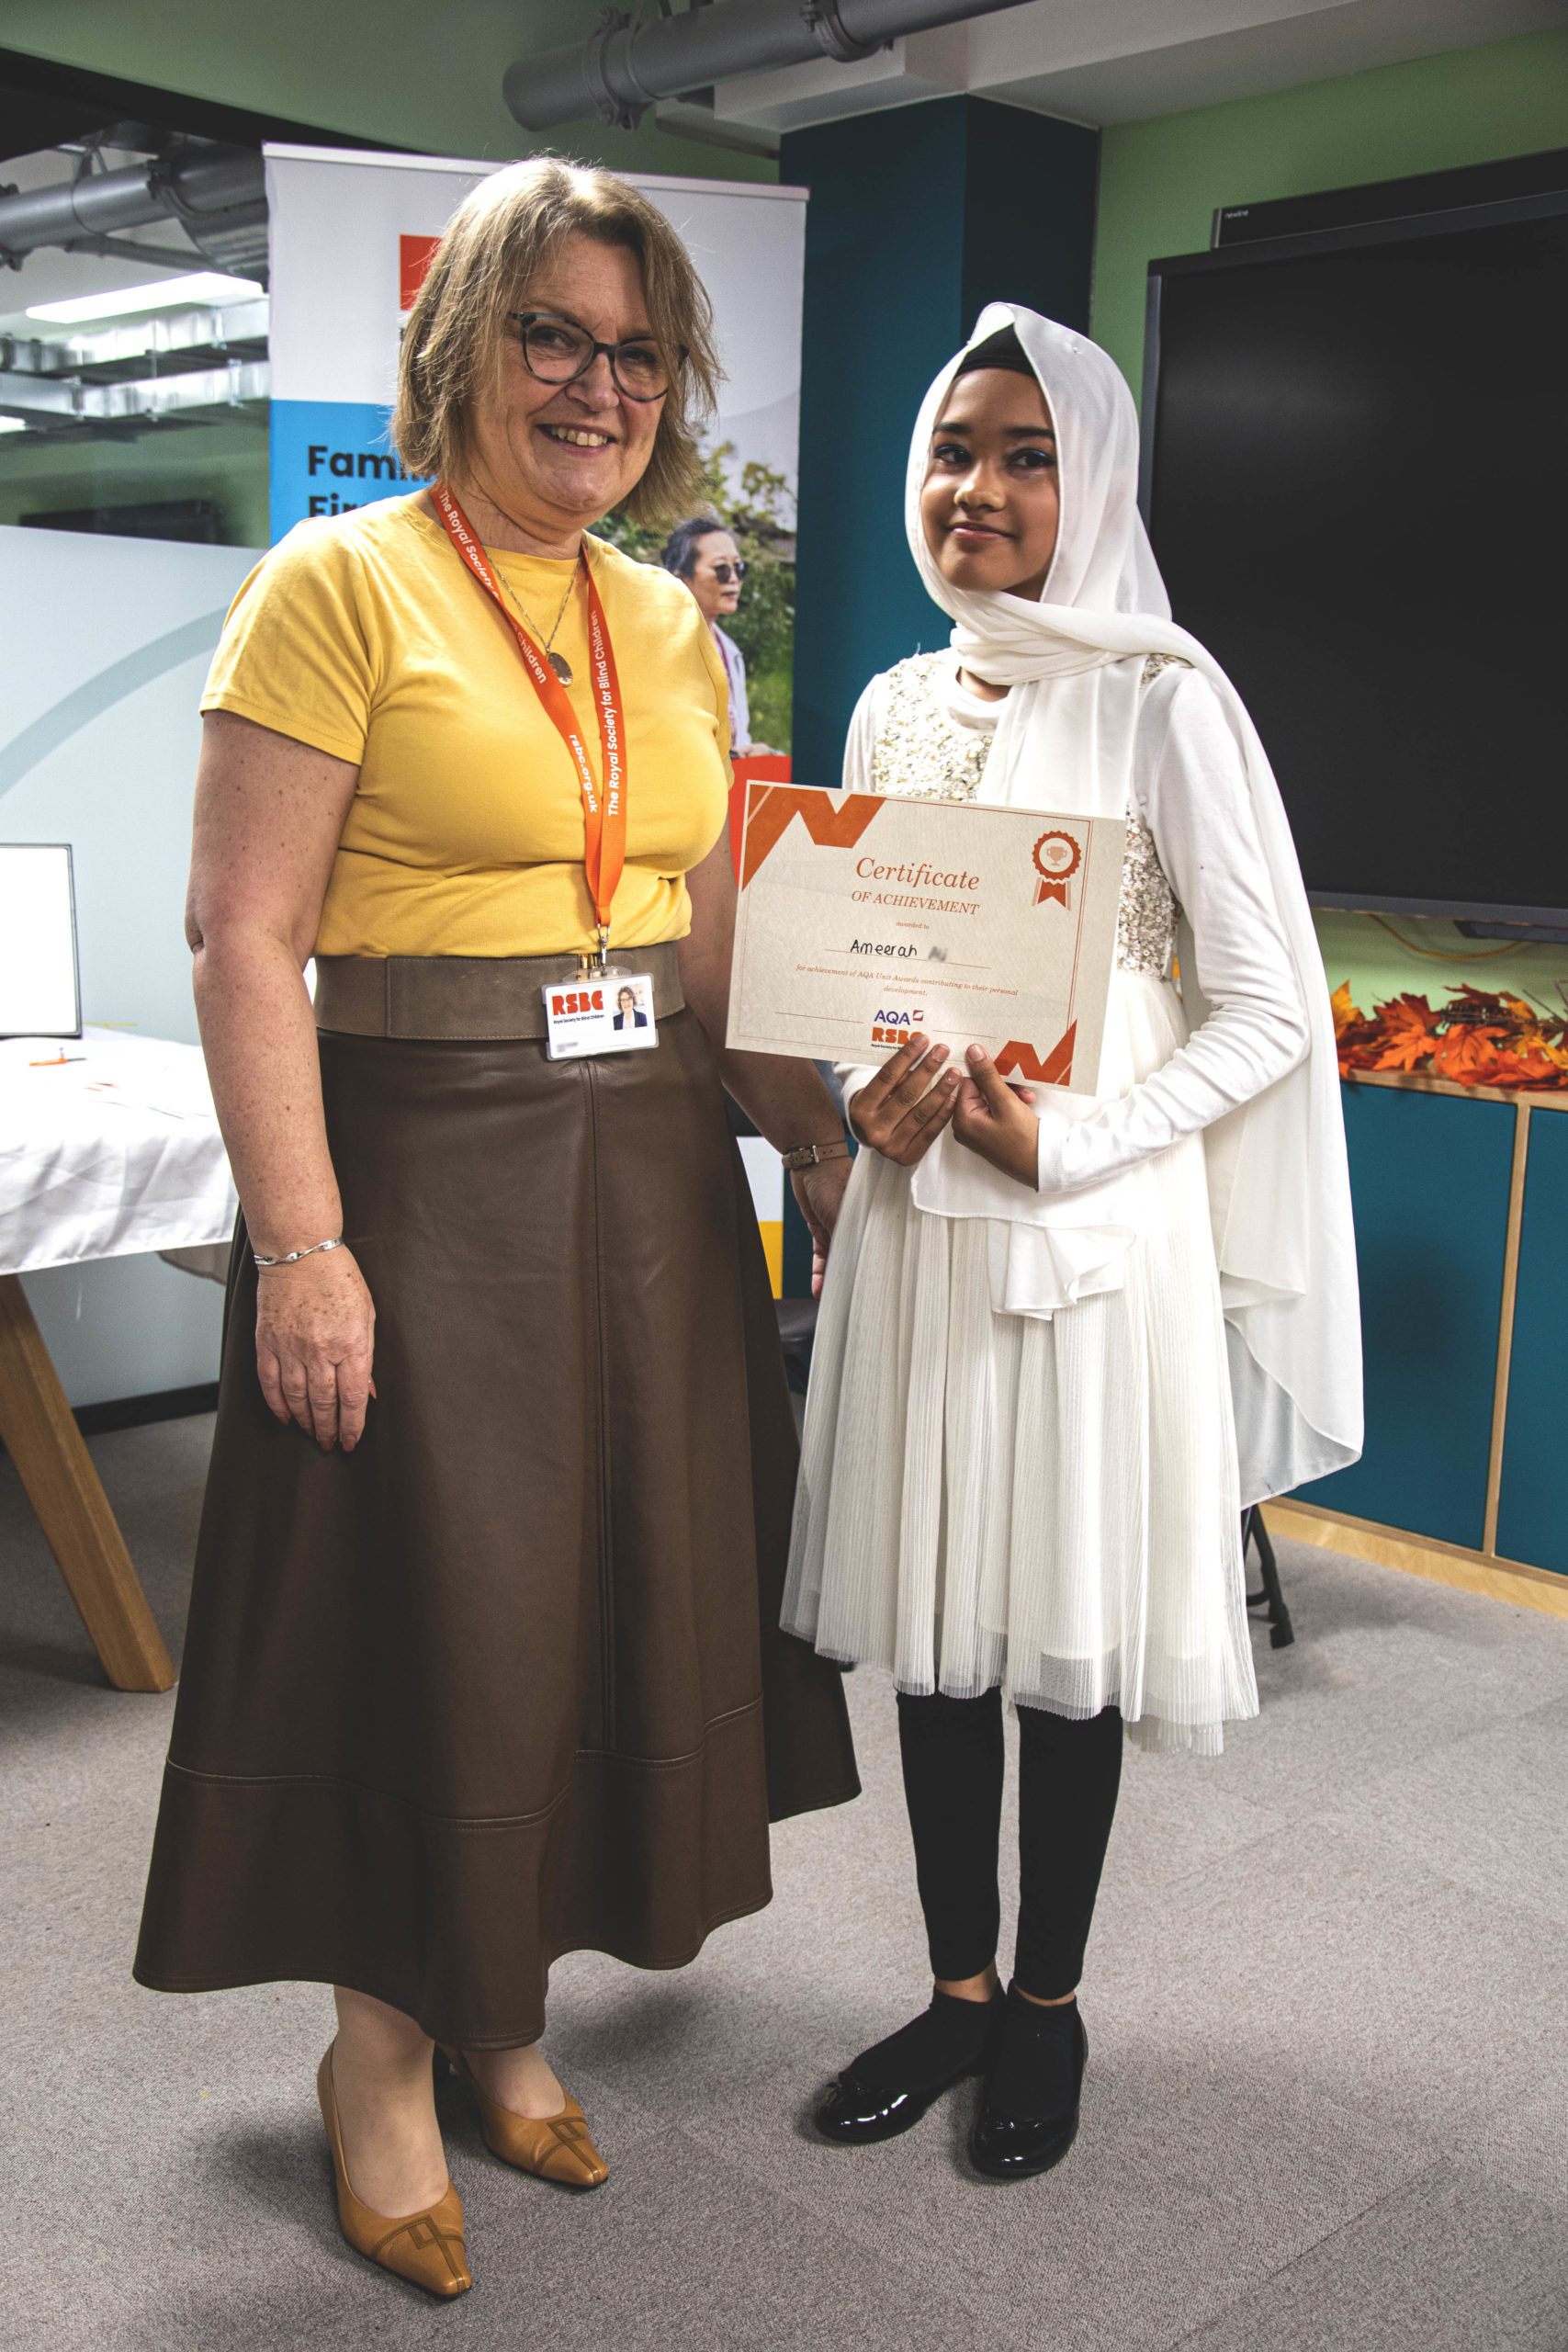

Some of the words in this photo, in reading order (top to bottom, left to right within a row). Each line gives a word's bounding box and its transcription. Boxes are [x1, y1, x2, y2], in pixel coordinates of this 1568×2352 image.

[439, 491, 452, 512] The
[447, 511, 472, 544] Royal
[466, 545, 493, 589] Society
[591, 610, 605, 660] Children
[596, 661, 610, 689] Blind
[601, 690, 612, 706] for
[604, 707, 617, 750] Society
[607, 752, 622, 789] Royal
[607, 791, 619, 816] The
[856, 857, 979, 890] Certificate
[851, 890, 872, 902] OF
[873, 893, 980, 915] ACHIEVEMENT
[851, 939, 918, 958] Ameerah
[807, 966, 848, 976] achievement
[857, 971, 874, 979] AQA
[892, 975, 919, 983] Awards
[920, 978, 963, 989] contributing
[972, 983, 988, 991] their
[989, 988, 1019, 996] personal
[552, 990, 604, 1016] RSBC
[874, 1010, 910, 1025] AQA
